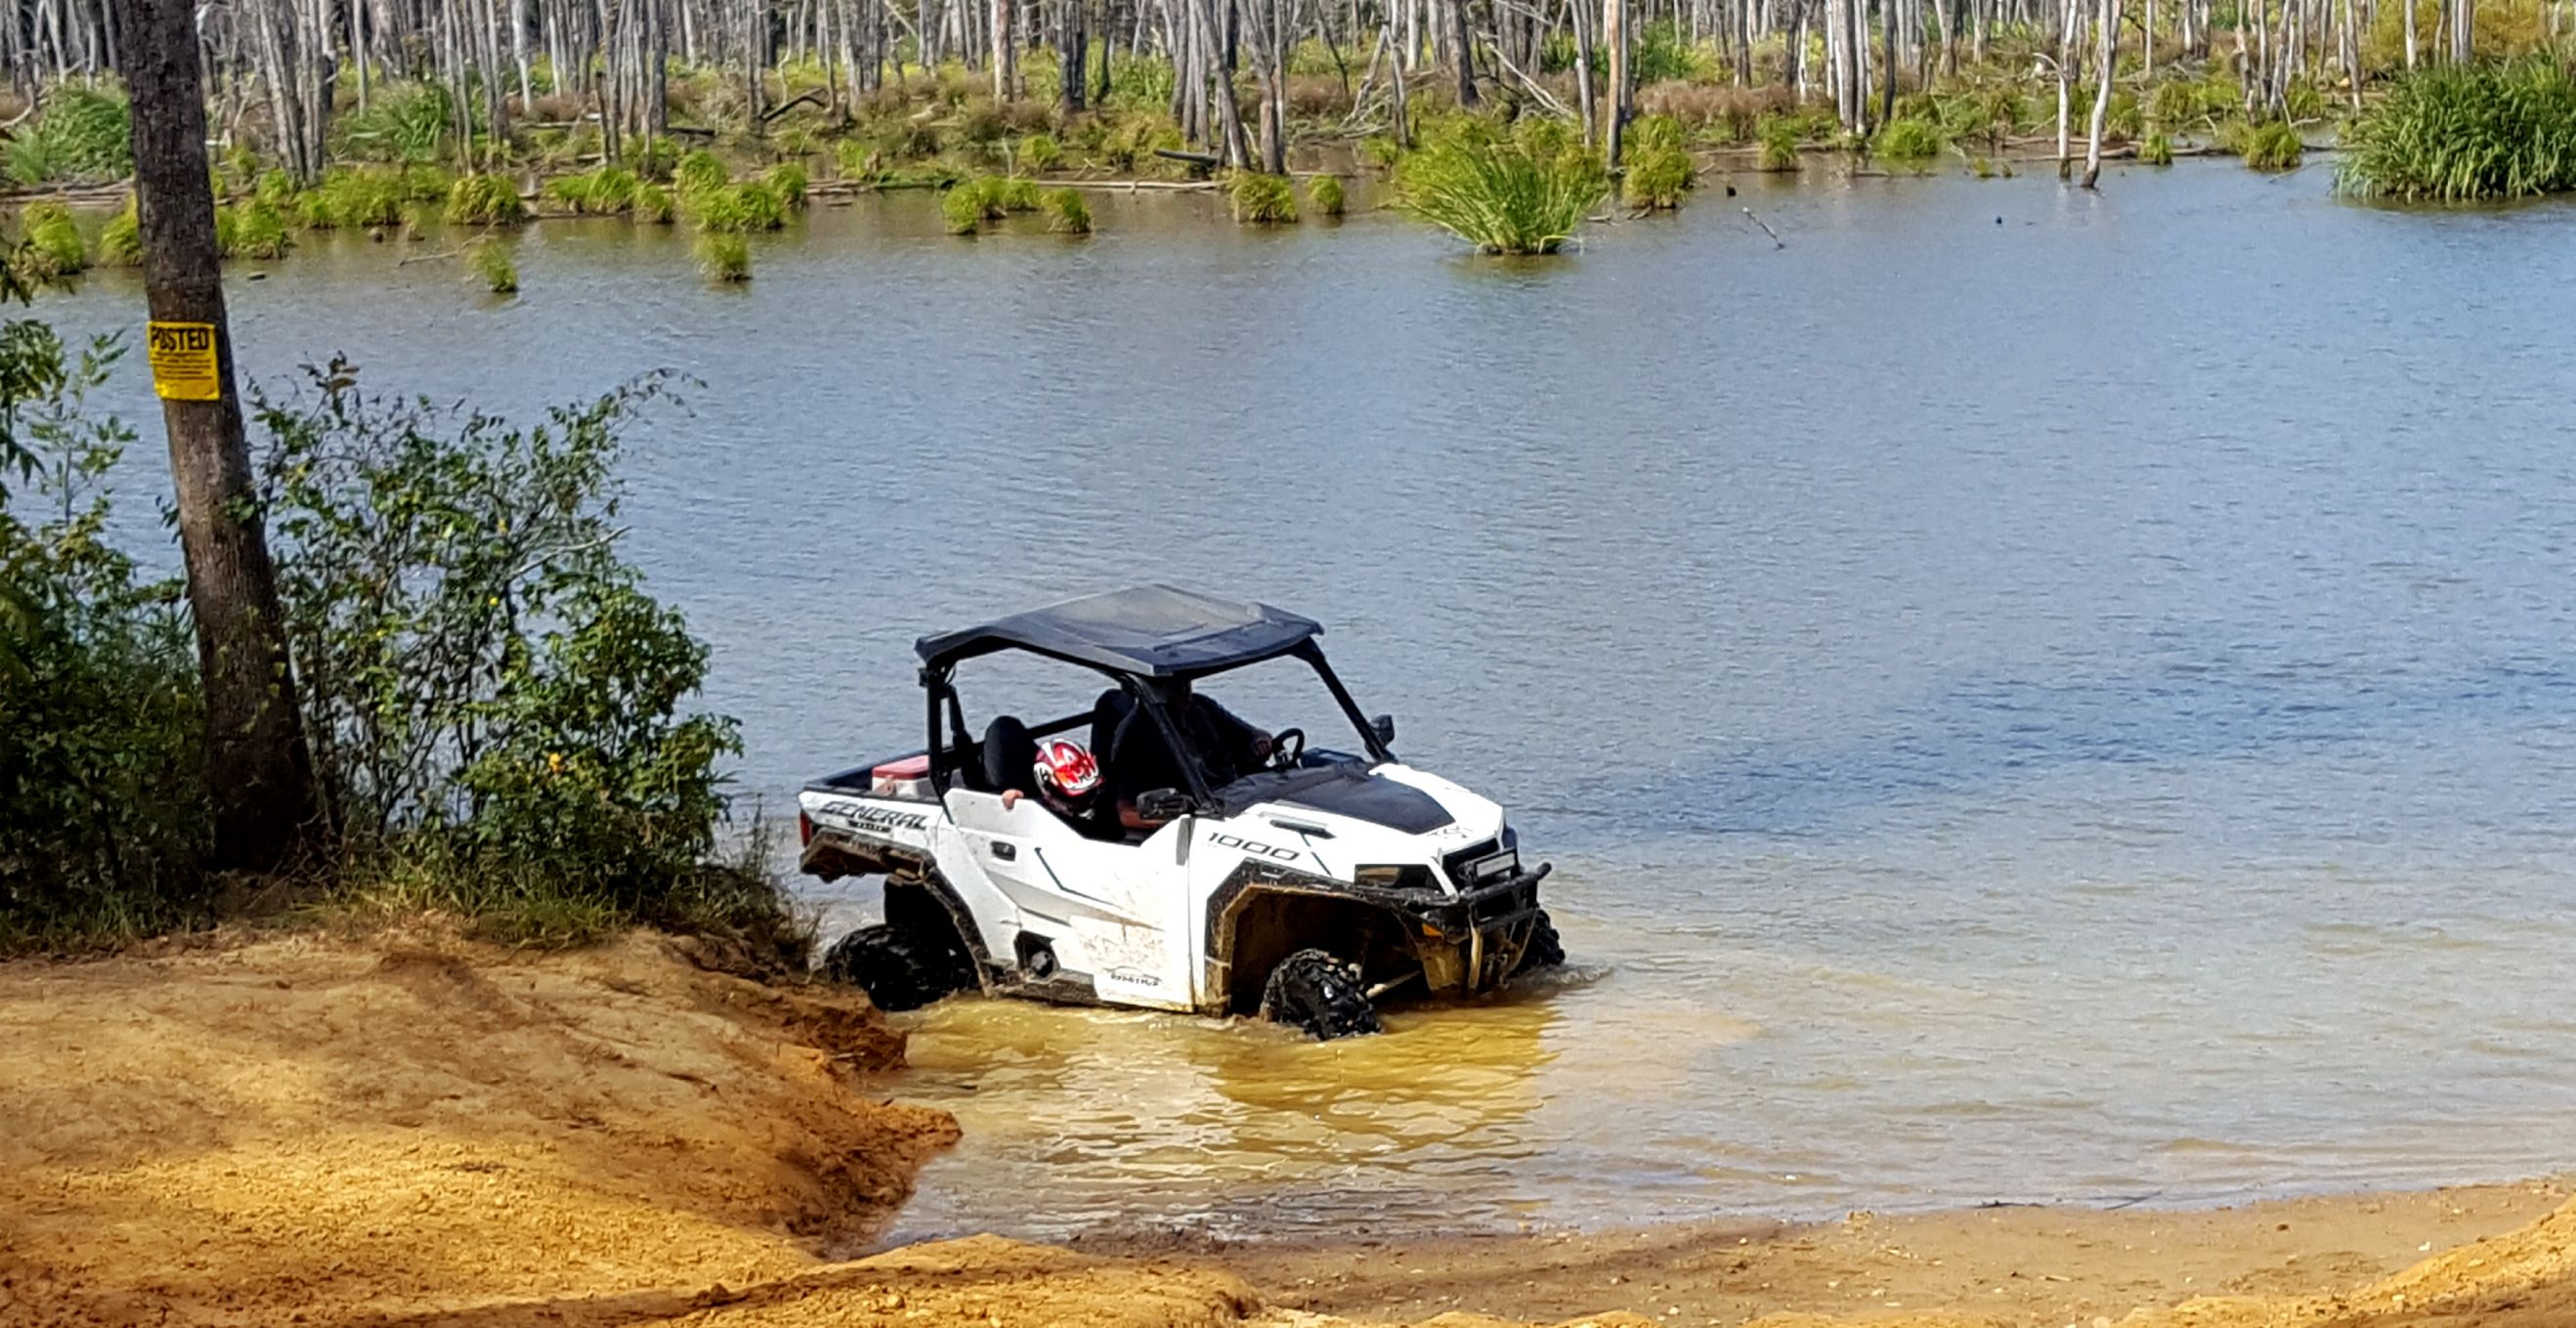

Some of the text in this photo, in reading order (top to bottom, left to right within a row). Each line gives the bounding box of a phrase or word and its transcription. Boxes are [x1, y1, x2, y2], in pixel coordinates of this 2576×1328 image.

[150, 326, 209, 351] POSTED
[820, 800, 928, 831] GENERAL
[1209, 833, 1300, 861] 1000
